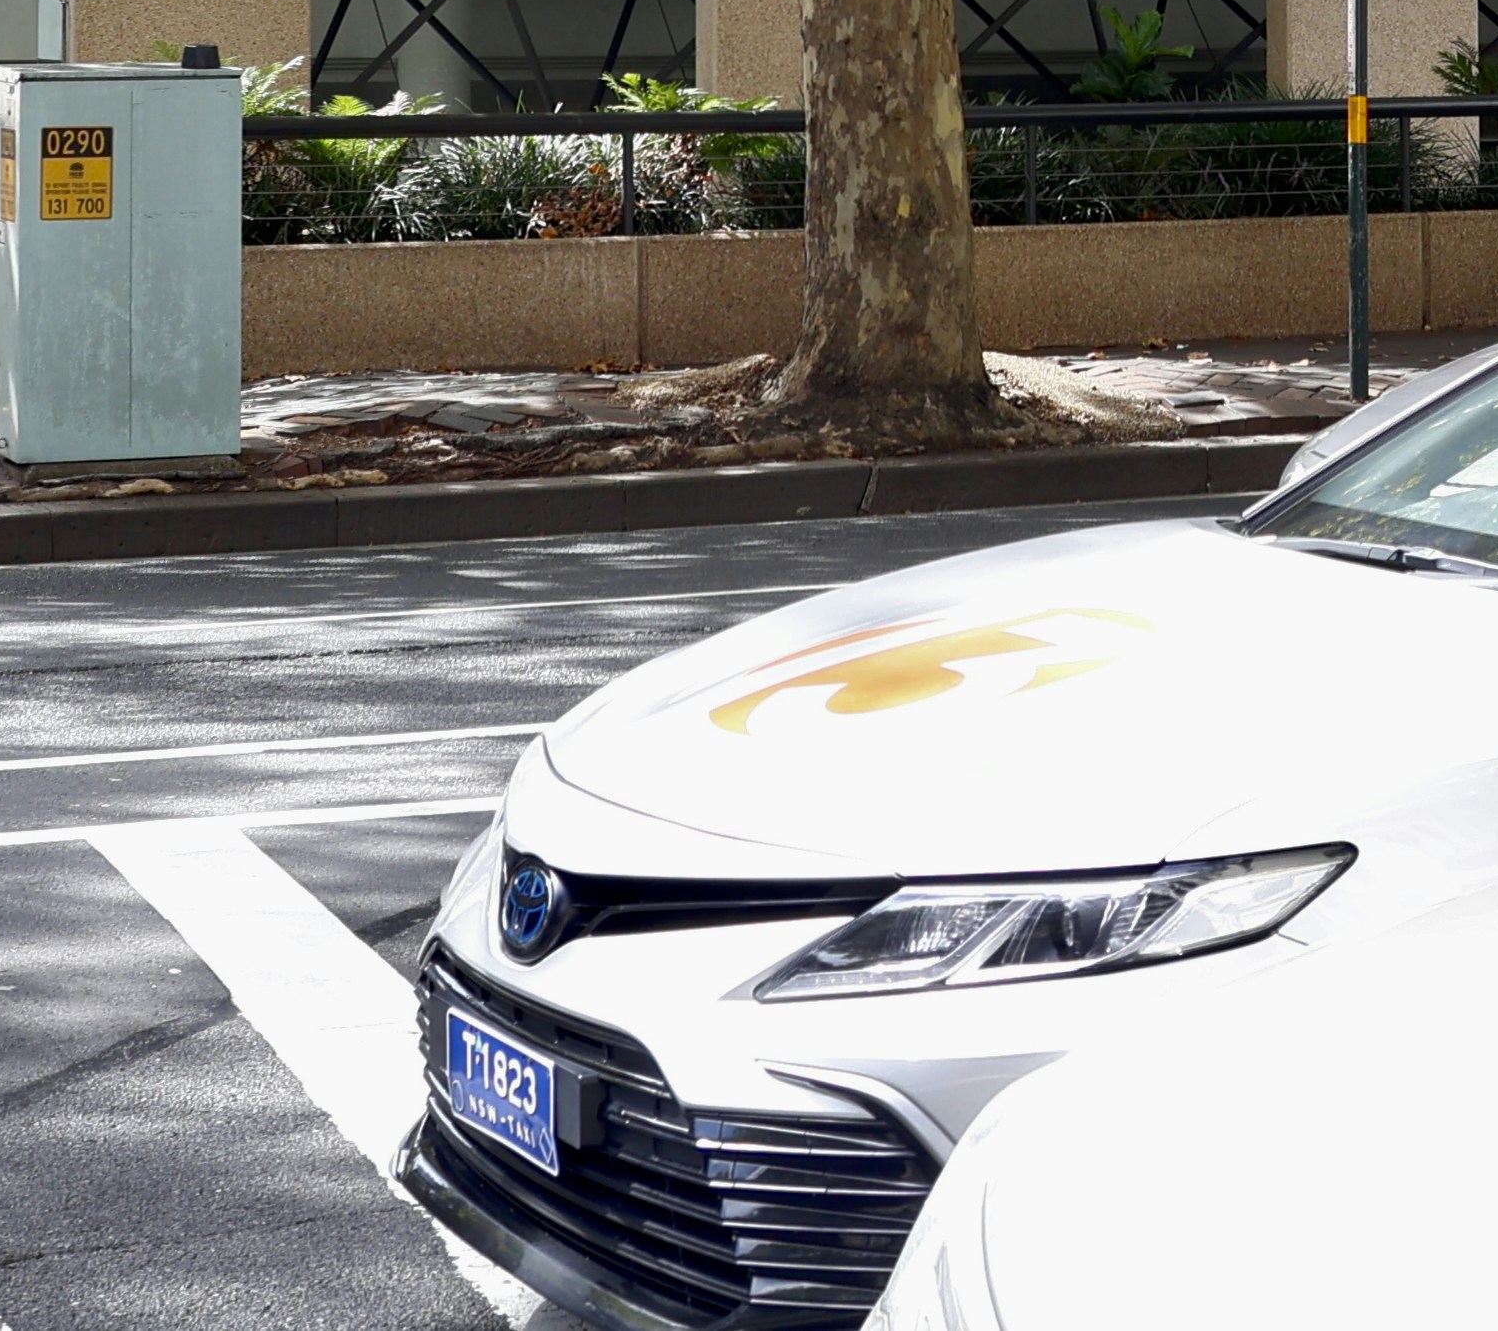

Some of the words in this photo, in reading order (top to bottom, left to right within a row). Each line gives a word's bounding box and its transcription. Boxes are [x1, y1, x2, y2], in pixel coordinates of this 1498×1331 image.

[47, 130, 105, 155] 0290
[48, 199, 68, 215] 131
[76, 198, 104, 214] 700
